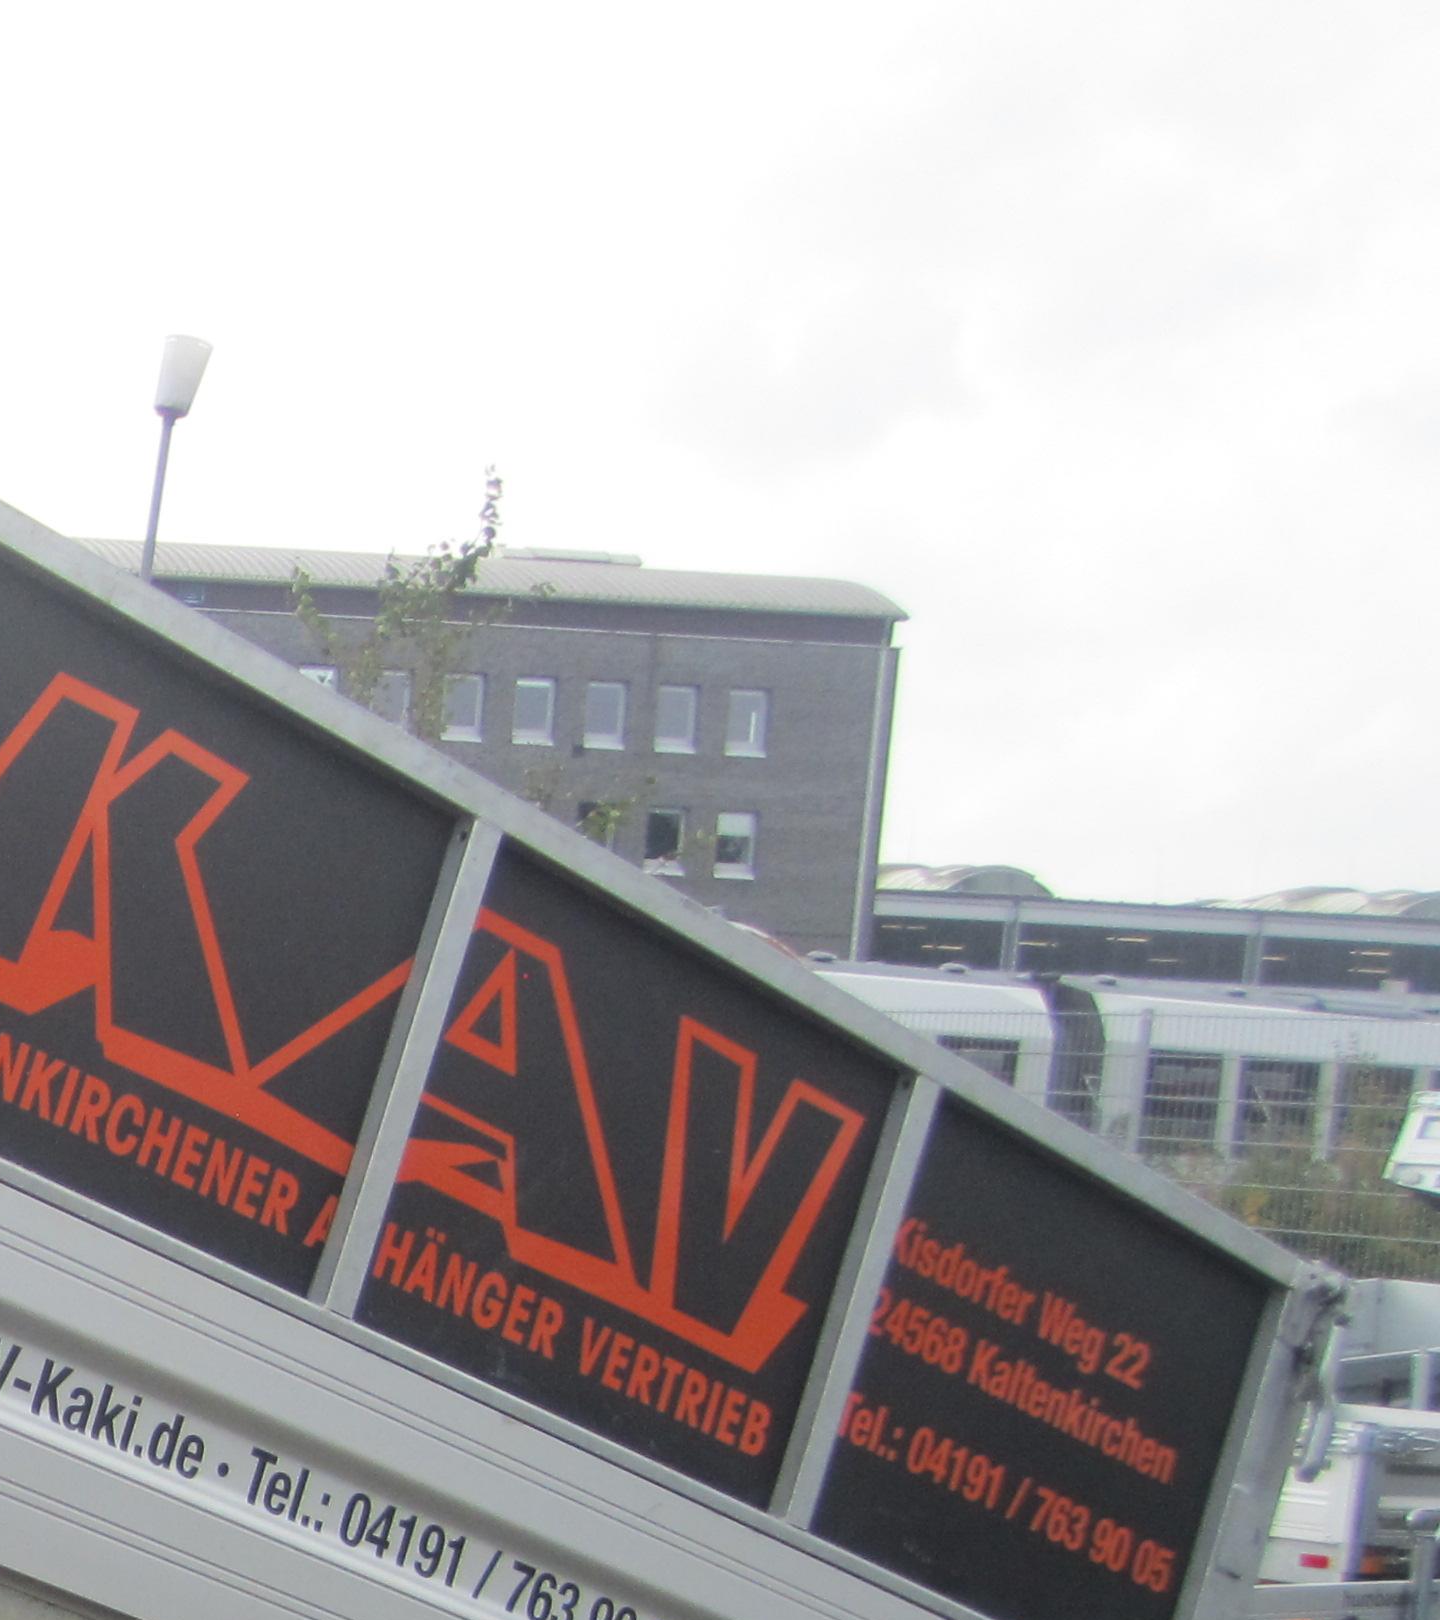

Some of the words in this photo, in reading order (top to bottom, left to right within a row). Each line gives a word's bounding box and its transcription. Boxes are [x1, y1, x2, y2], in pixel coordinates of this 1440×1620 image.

[303, 1194, 564, 1360] AHÄNGER
[579, 1317, 772, 1456] VERTRIEB
[869, 1285, 968, 1374] 24568
[967, 1338, 1178, 1485] Kaltenkirchen
[1038, 1291, 1107, 1374] Weg
[1105, 1332, 1152, 1389] 22
[245, 1446, 333, 1532] Tel.:
[337, 1491, 469, 1590] 04191
[472, 1548, 501, 1598] /
[837, 1392, 905, 1462] Tel.:
[906, 1427, 1006, 1510] 04191
[1004, 1476, 1031, 1519] /
[1031, 1489, 1088, 1551] 763
[1088, 1516, 1134, 1573] 90
[1132, 1539, 1177, 1594] 05
